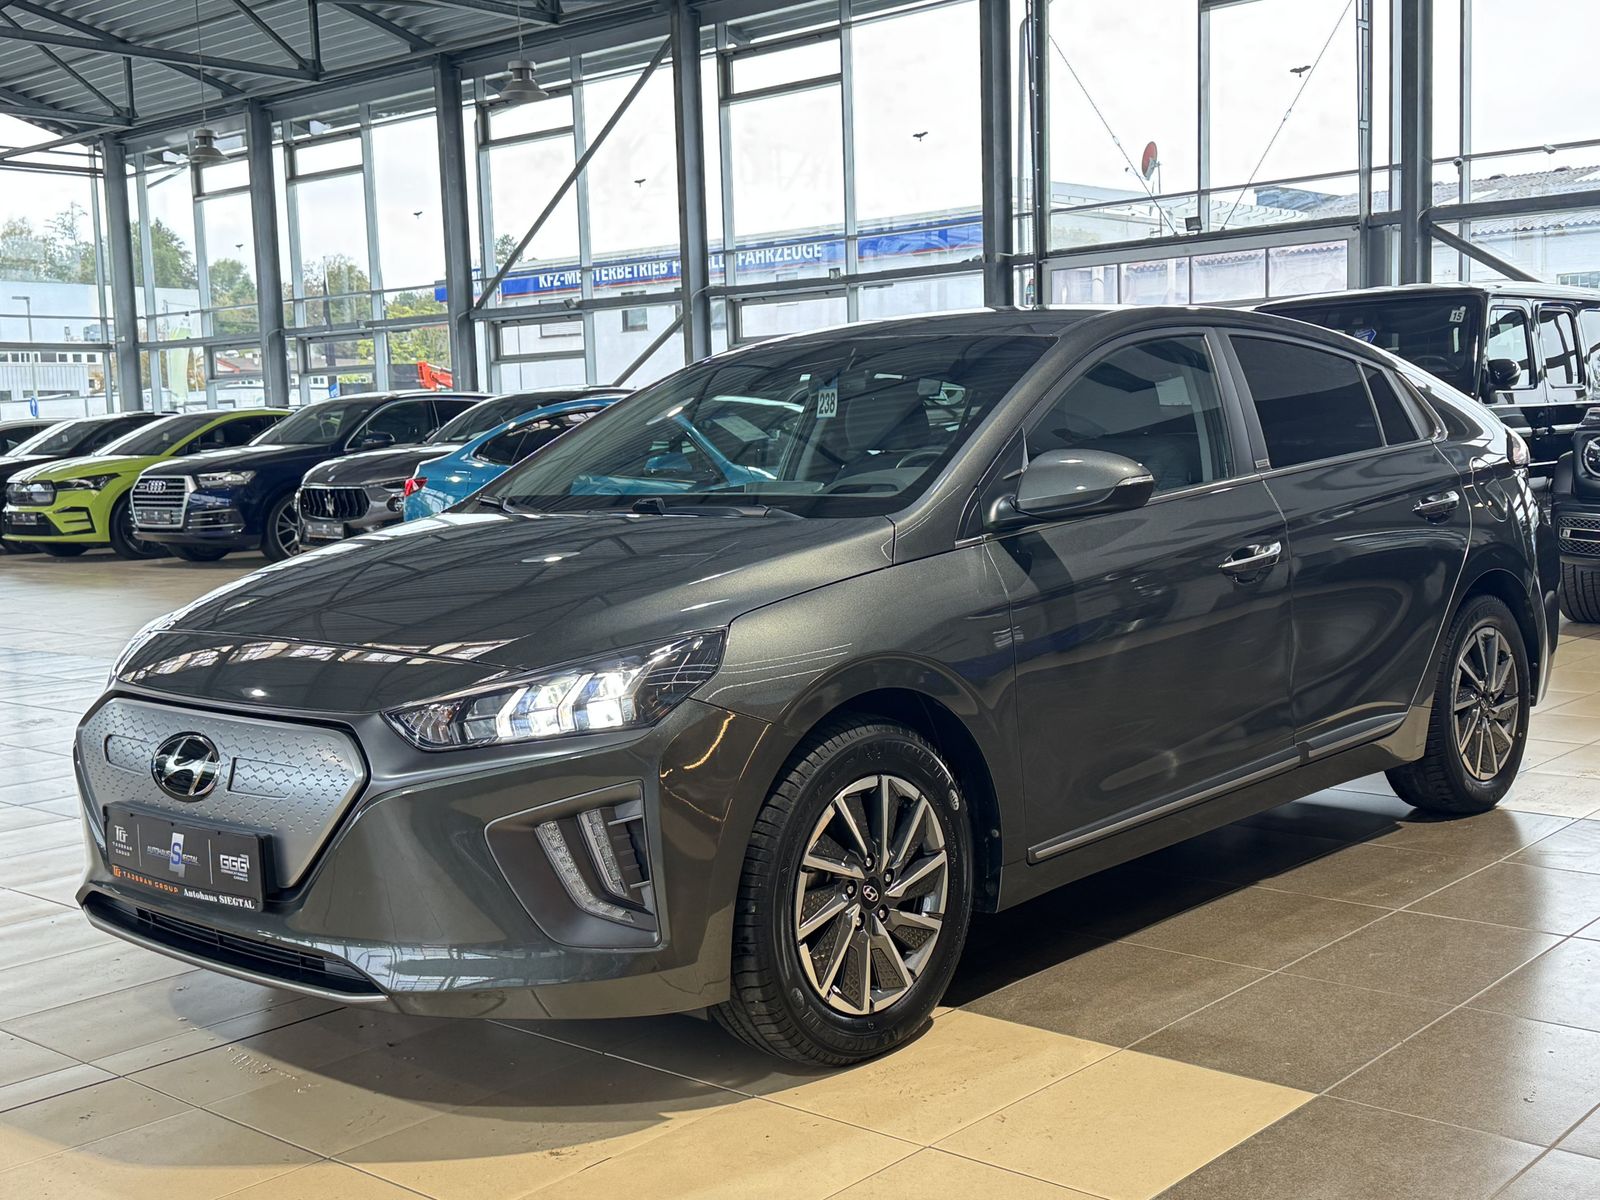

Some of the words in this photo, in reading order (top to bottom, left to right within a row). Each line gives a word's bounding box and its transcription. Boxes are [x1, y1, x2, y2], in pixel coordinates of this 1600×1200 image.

[538, 261, 668, 288] KFZ-METERBETRIEB
[738, 243, 823, 266] FAHRZEUGE
[1452, 310, 1464, 321] 15
[818, 392, 836, 414] 238
[154, 881, 179, 893] GROUP
[183, 887, 218, 903] Autohaus
[218, 894, 255, 909] SIEGTAL
